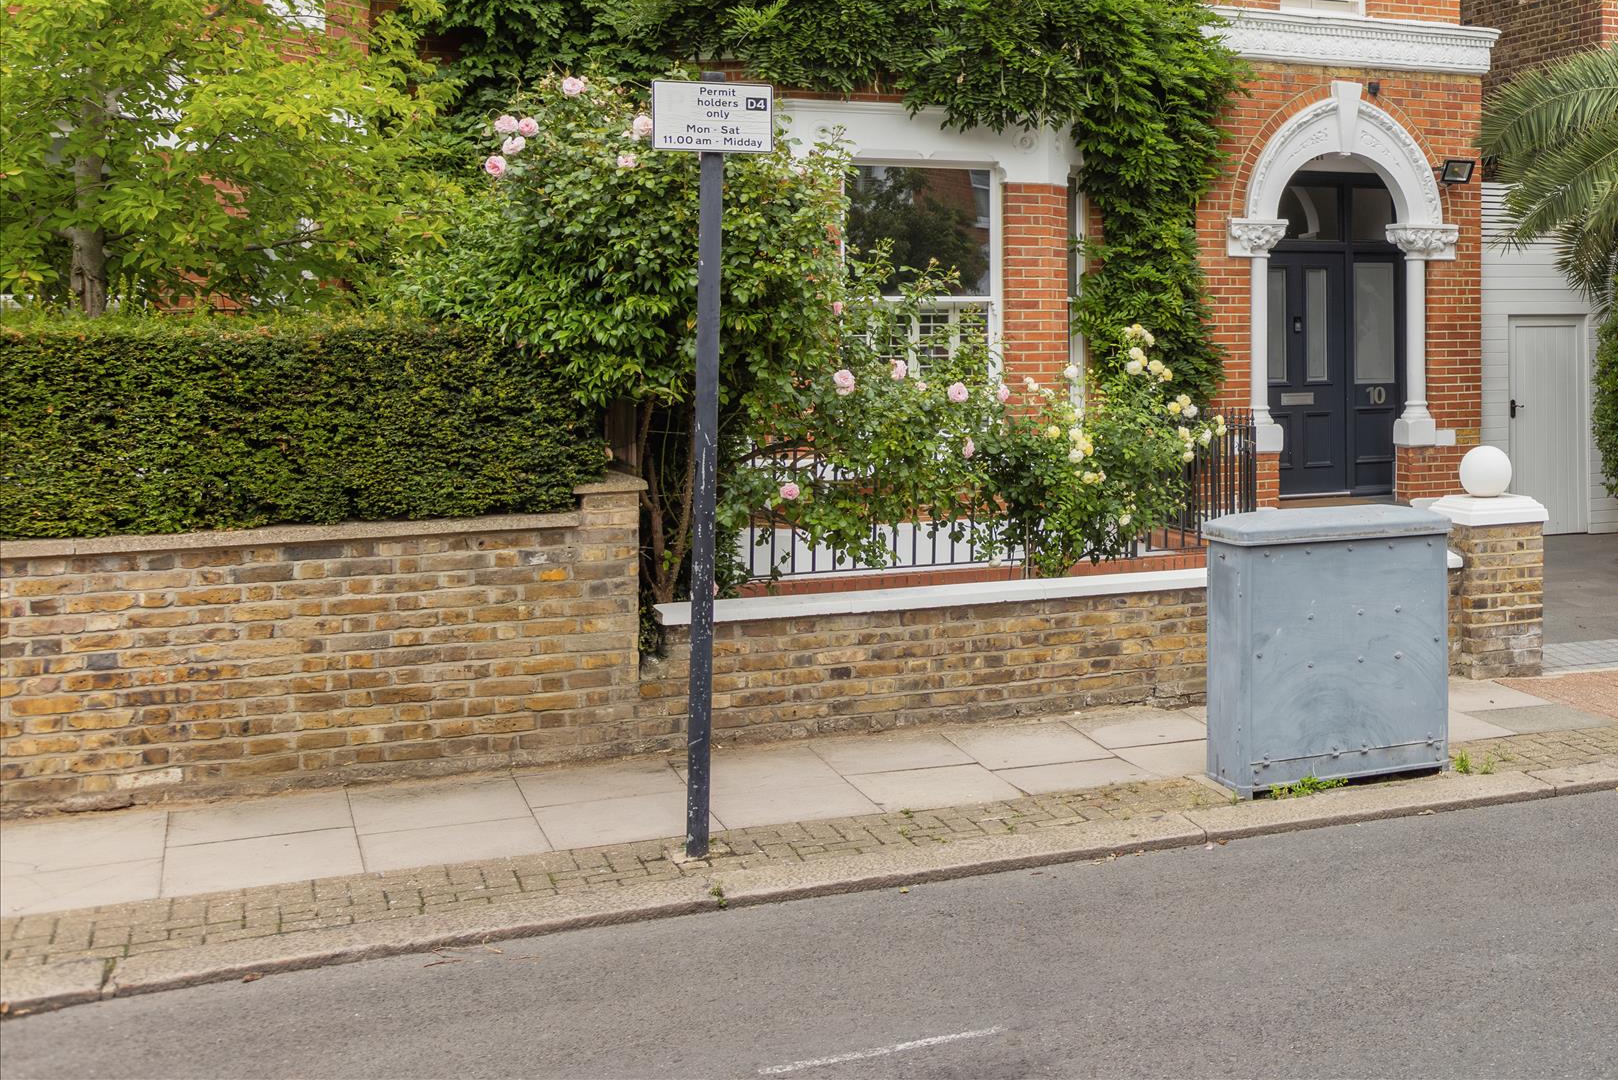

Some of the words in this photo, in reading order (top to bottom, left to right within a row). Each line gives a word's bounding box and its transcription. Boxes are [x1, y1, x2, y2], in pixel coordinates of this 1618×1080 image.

[699, 87, 736, 97] Permit
[697, 98, 739, 108] holders
[747, 99, 766, 110] D4
[706, 109, 730, 120] only
[686, 124, 710, 134] Mon
[720, 125, 741, 135] Sat
[663, 135, 693, 145] 11.00
[723, 137, 763, 148] Midday
[1365, 386, 1386, 405] 10
